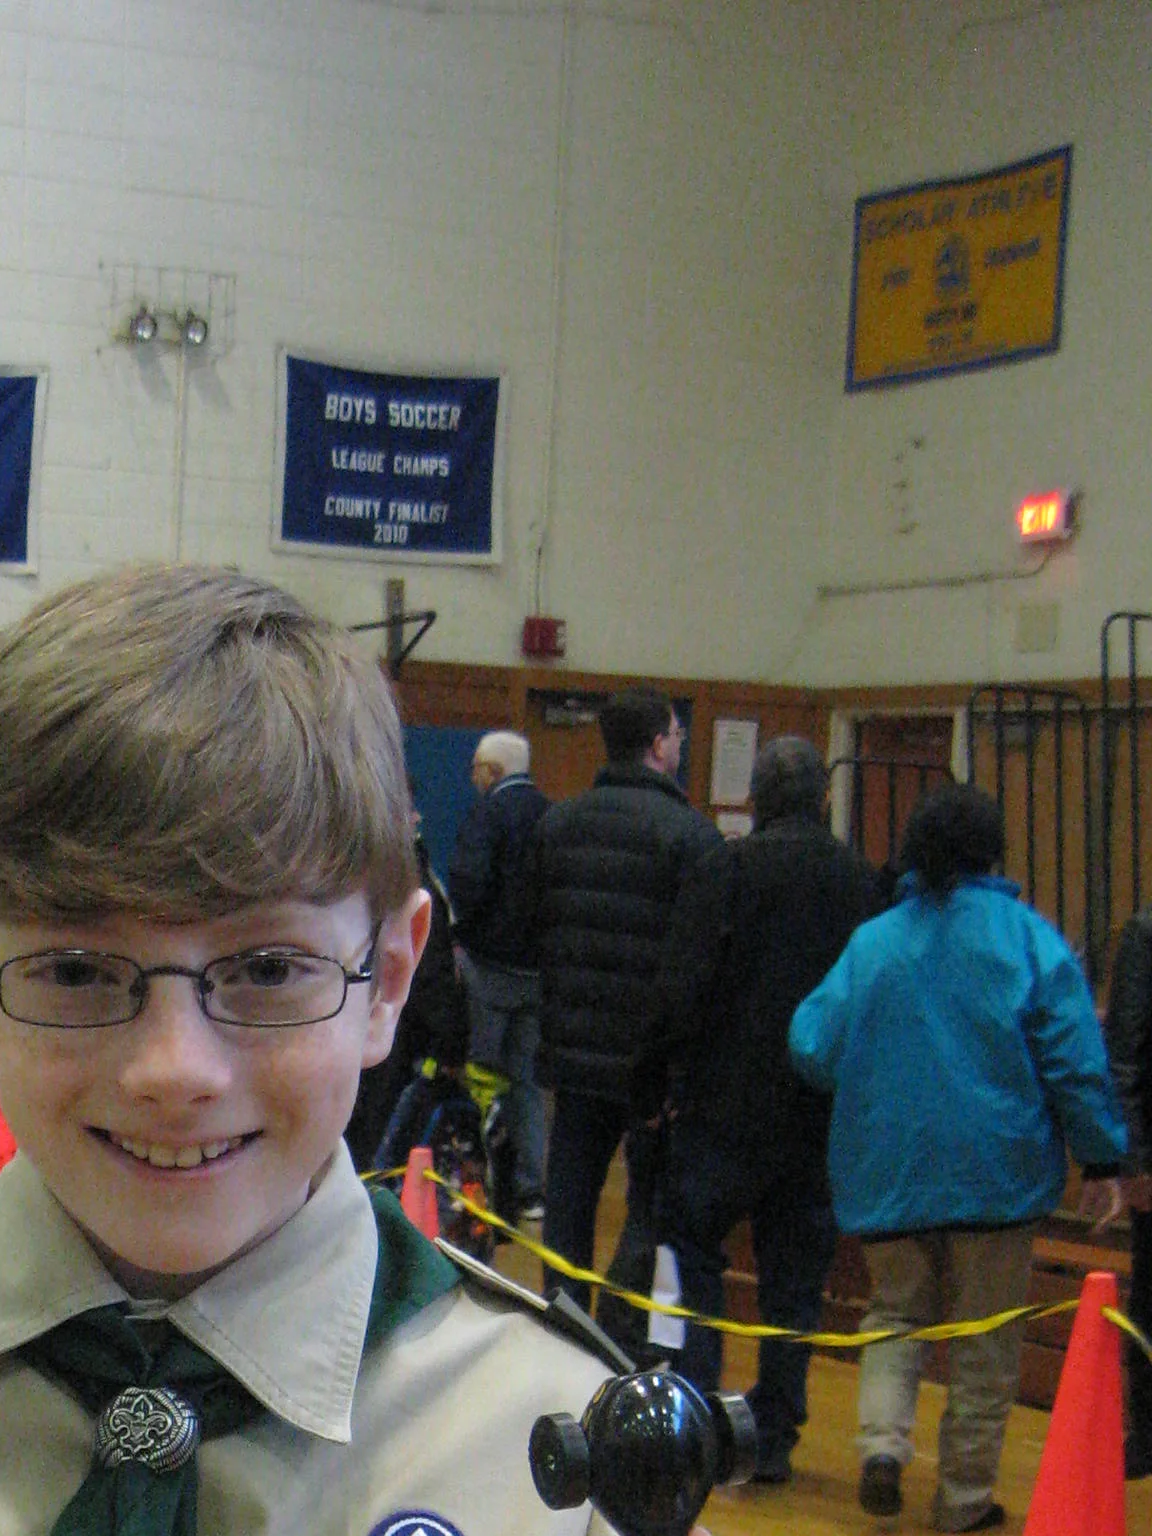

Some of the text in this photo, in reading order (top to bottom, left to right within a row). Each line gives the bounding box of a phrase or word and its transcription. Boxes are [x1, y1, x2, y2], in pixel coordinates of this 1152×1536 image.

[324, 393, 461, 432] BOYS SOCCER
[332, 448, 450, 478] LEAGUE CHAMPS
[323, 496, 448, 524] COUNTY FINALIST
[373, 523, 409, 545] 2010
